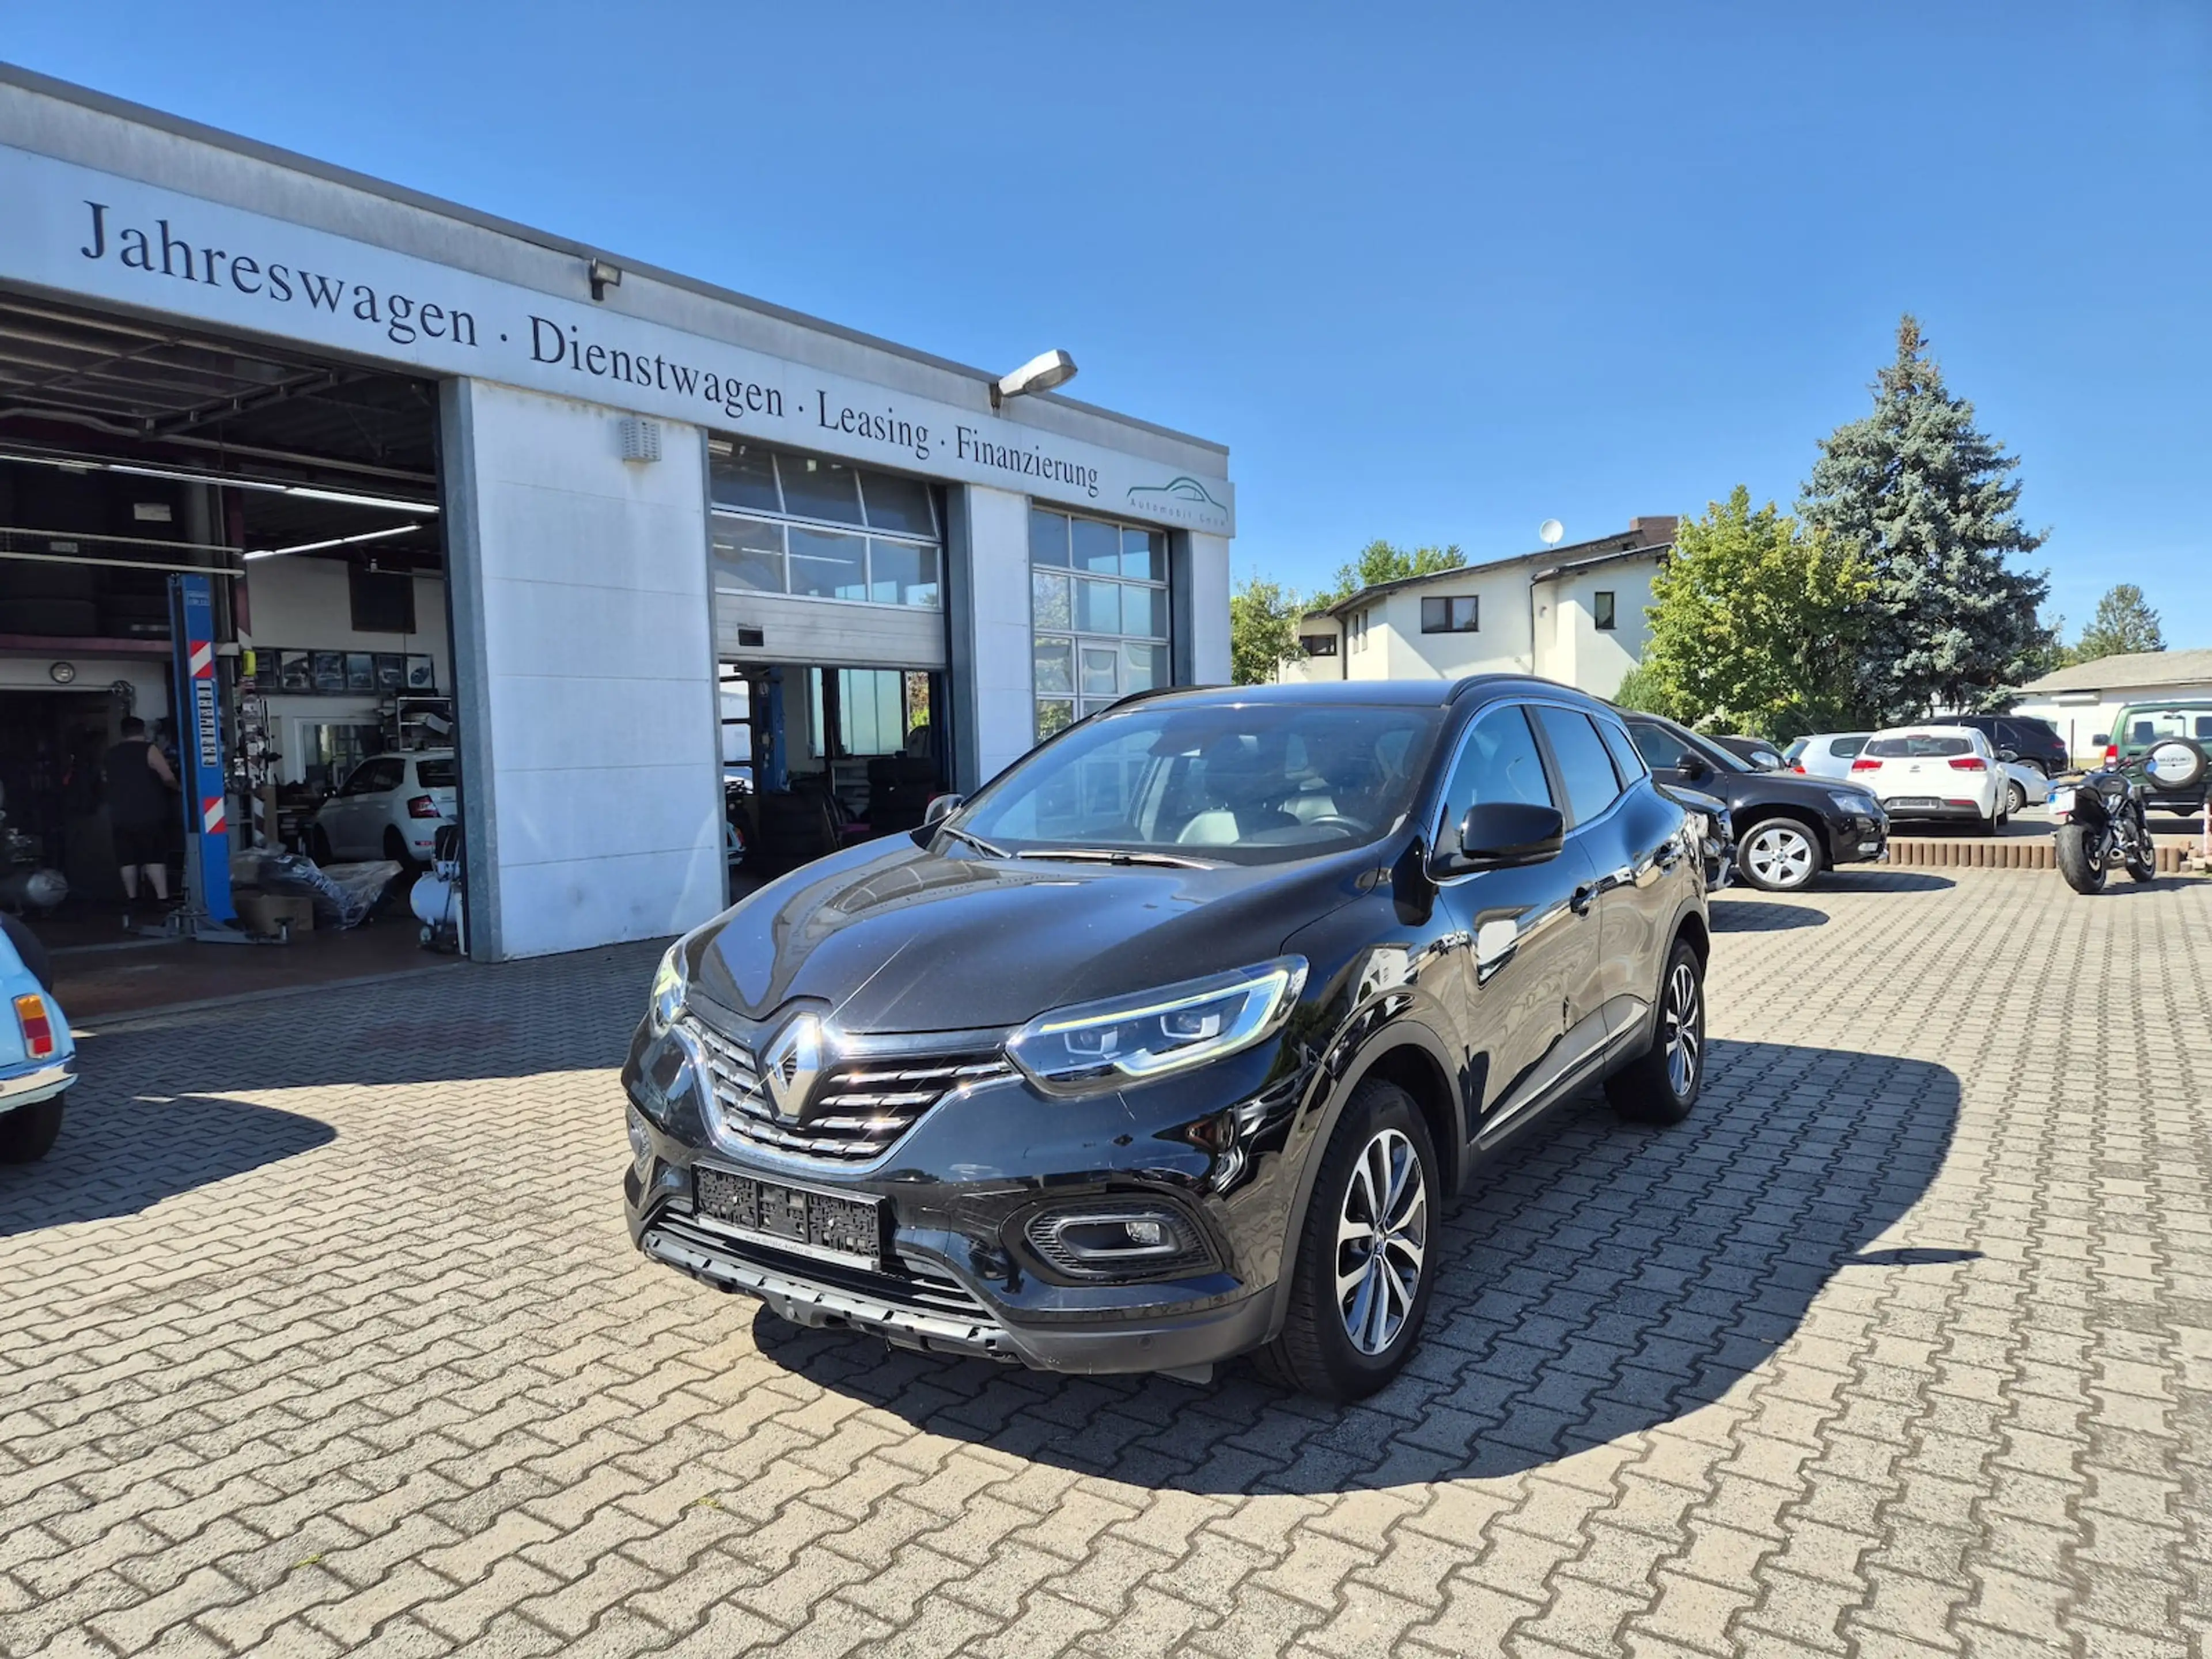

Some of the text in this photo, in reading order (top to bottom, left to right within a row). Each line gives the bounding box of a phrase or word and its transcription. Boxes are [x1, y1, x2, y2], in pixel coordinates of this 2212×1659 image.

[81, 201, 1099, 498] Jahreswagen Dienstwagen Leasing Finanzierung
